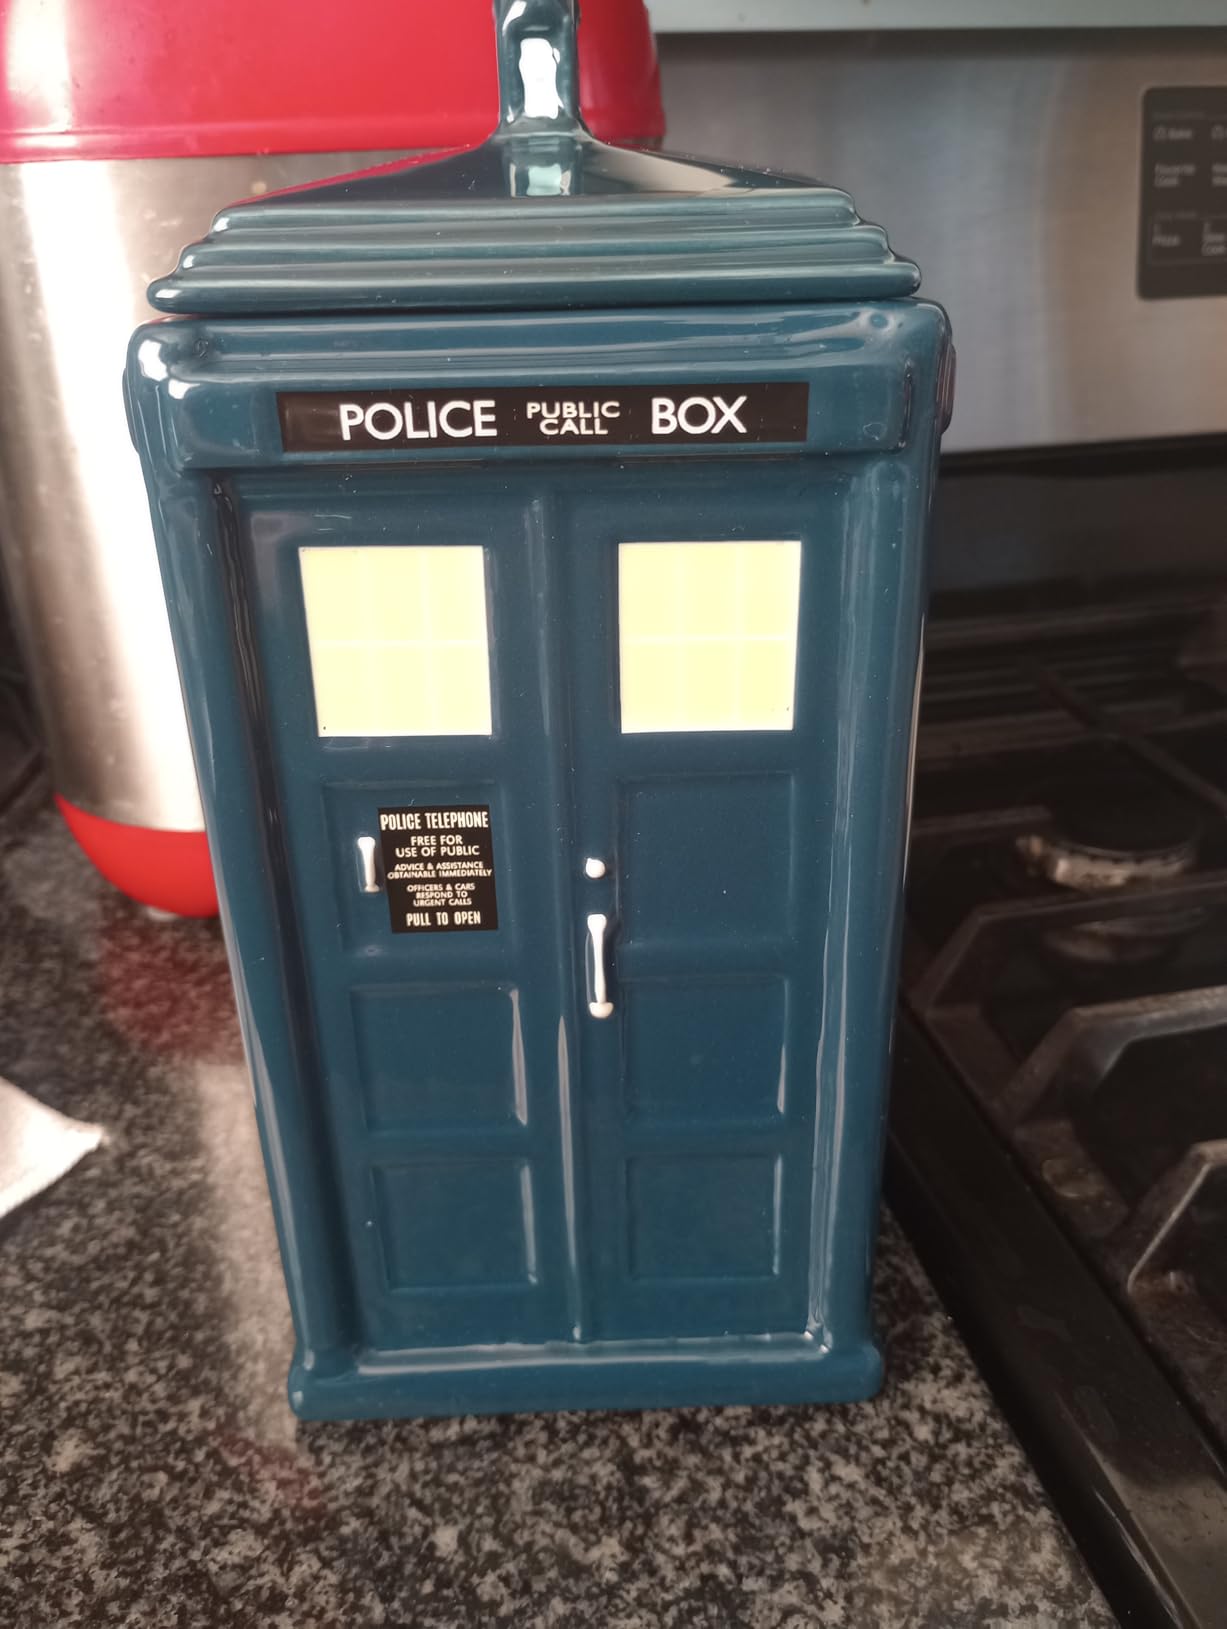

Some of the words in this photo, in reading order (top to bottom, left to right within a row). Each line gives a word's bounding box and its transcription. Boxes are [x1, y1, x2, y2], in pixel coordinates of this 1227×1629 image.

[525, 400, 621, 419] PUBLIC
[651, 395, 747, 434] BOX
[339, 399, 498, 441] POLICE
[539, 418, 608, 436] CALL
[380, 813, 422, 831] POLICE
[424, 811, 489, 829] TELEPHONE
[410, 836, 436, 846] FREE
[440, 834, 463, 845] FOR
[395, 847, 418, 857] USE
[421, 847, 436, 856] OF
[440, 845, 480, 856] PUBLIC
[394, 863, 425, 871] ADVICE
[427, 862, 434, 870] &
[436, 861, 484, 870] ASSISTANCE
[387, 870, 436, 880] OBTAINABLE
[439, 869, 492, 877] IMMEDIATELY
[406, 884, 443, 892] OFFICERS
[413, 899, 446, 907] URGENT
[448, 898, 472, 906] CALLS
[406, 913, 431, 926] PULL
[436, 912, 449, 926] TO
[454, 911, 481, 925] OPEN
